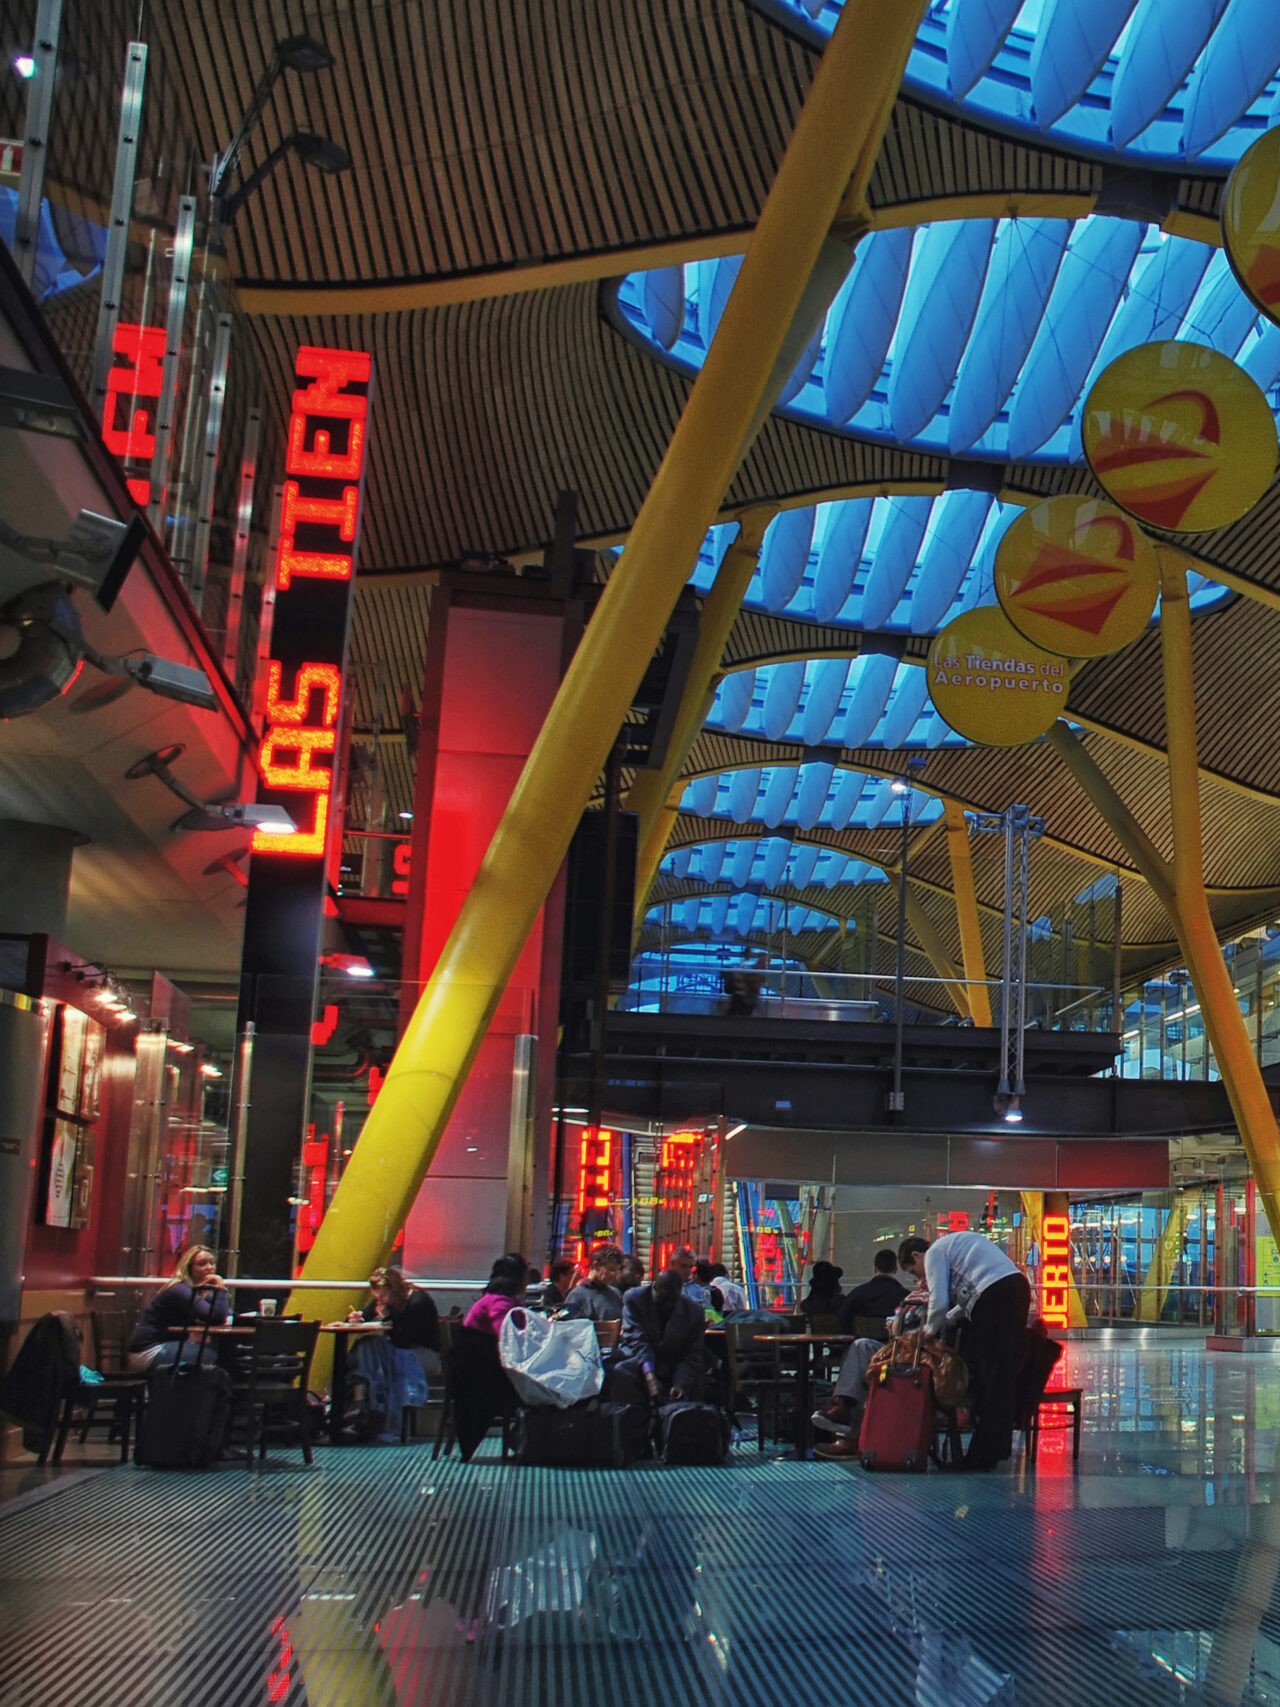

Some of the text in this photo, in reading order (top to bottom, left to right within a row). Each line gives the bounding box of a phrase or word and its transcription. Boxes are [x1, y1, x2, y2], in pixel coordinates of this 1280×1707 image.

[934, 653, 1064, 677] Las Tiendas del
[935, 672, 1064, 693] Aeropuerto
[251, 658, 342, 858] LAS
